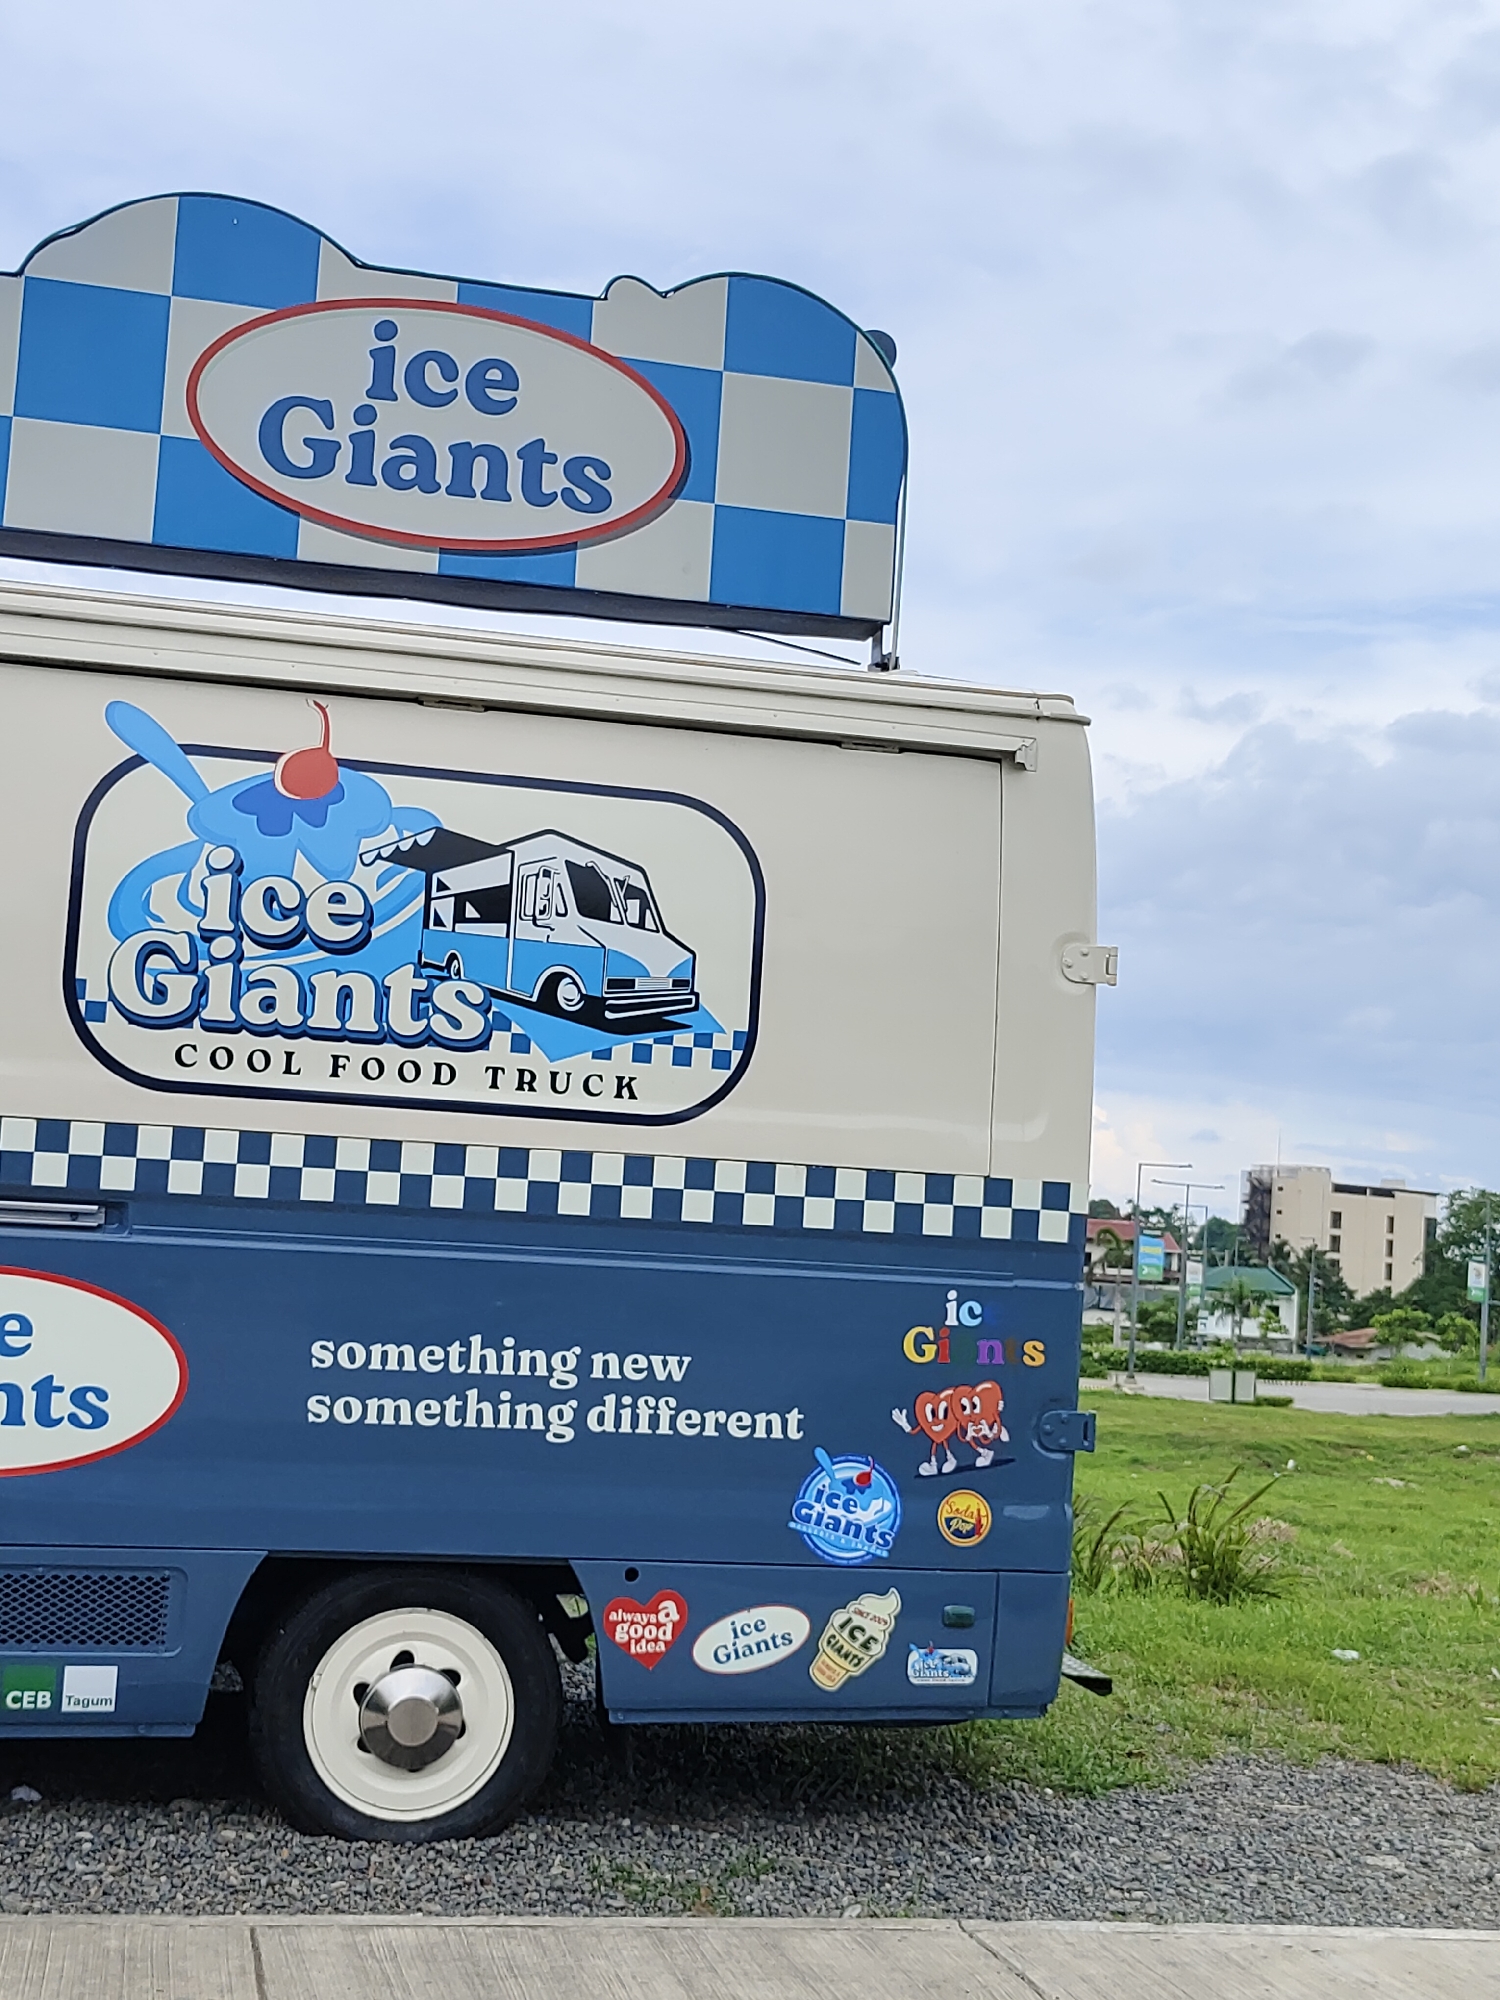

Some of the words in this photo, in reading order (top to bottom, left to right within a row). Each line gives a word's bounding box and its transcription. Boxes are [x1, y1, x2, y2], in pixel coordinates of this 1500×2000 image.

[366, 319, 519, 415] ice
[258, 395, 613, 514] Giants
[199, 845, 374, 955] ice
[108, 929, 493, 1050] Giants
[174, 1043, 302, 1077] COOL
[329, 1054, 458, 1087] FOOD
[485, 1066, 639, 1101] TRUCK
[944, 1289, 1001, 1327] ic
[310, 1335, 582, 1390] something
[590, 1350, 692, 1382] new
[306, 1388, 578, 1443] something
[586, 1393, 805, 1440] different
[814, 1484, 859, 1515] ice
[794, 1501, 893, 1549] Giants
[608, 1608, 658, 1626] always
[657, 1600, 680, 1625] a
[730, 1618, 767, 1640] ice
[615, 1621, 674, 1645] good
[630, 1638, 667, 1655] idea
[713, 1631, 794, 1665] Giants
[825, 1633, 865, 1669] GIANTS
[838, 1616, 879, 1652] ICE
[5, 1690, 53, 1710] CEB
[65, 1694, 113, 1709] Tagum
